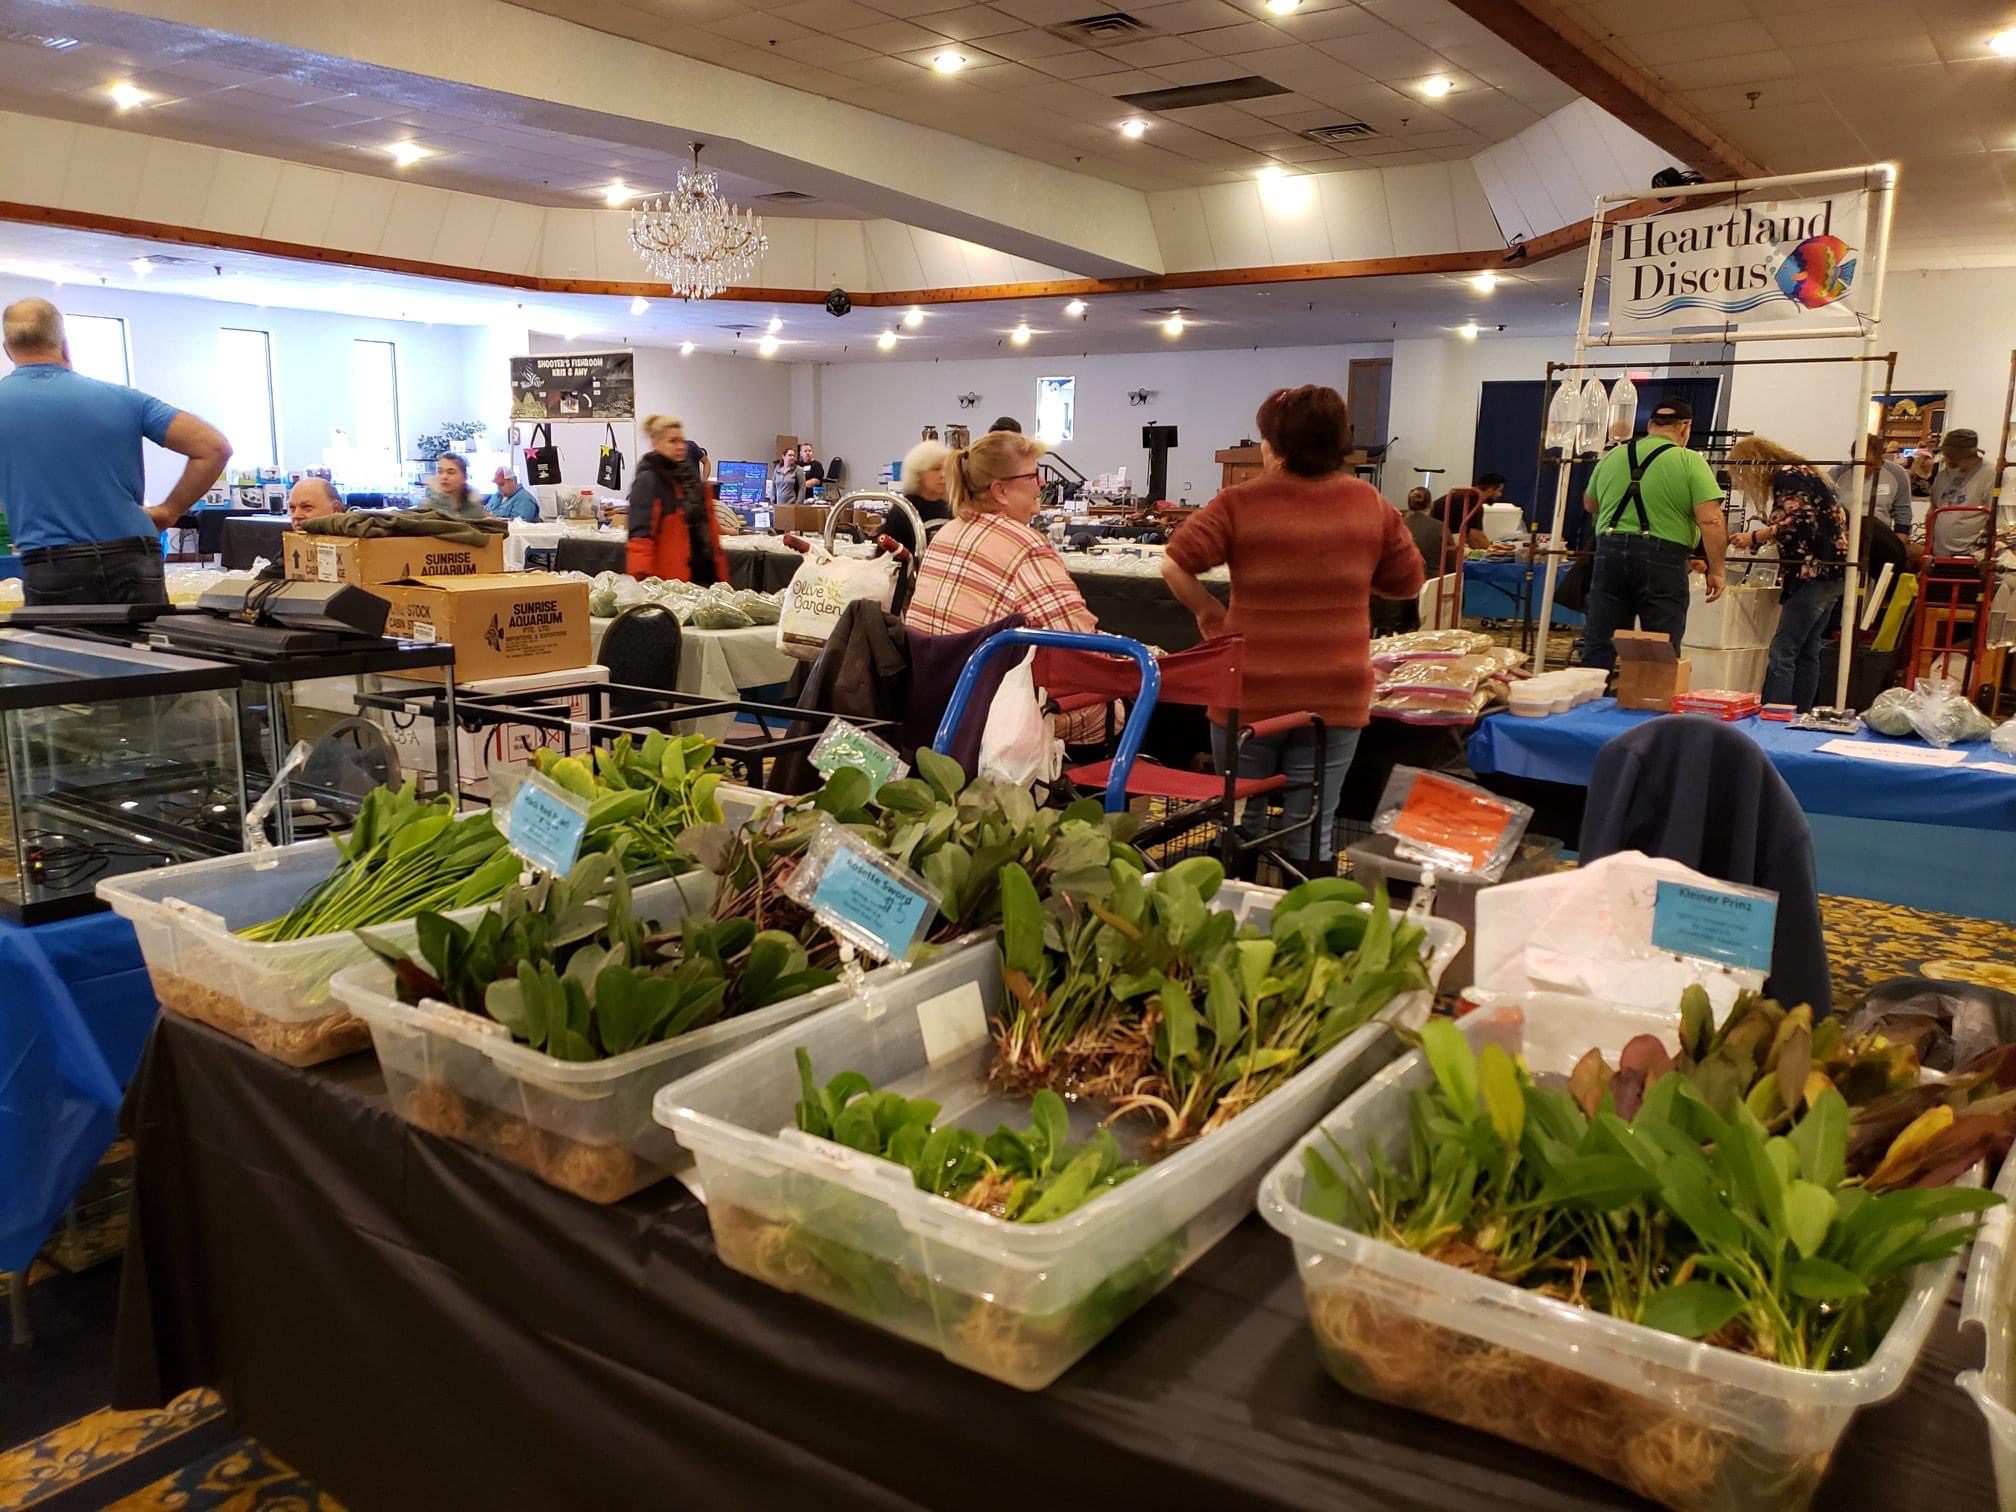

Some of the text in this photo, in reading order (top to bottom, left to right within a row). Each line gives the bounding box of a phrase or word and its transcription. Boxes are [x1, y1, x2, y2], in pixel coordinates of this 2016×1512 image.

[1616, 200, 1831, 261] Heartland
[1629, 261, 1768, 302] Discus
[571, 358, 603, 367] FISHROOM
[552, 368, 566, 376] KRIS
[574, 368, 588, 376] AMY
[425, 552, 471, 565] SUNRISE
[421, 563, 477, 576] AQUARIUM
[793, 580, 824, 598] Olive
[407, 604, 431, 618] STOCK
[513, 600, 557, 615] SUNRISE
[794, 595, 842, 615] Garden
[509, 611, 563, 628] AQUARIUM
[881, 881, 913, 906] Sword
[1679, 887, 1753, 912] Kleiner Prinz
